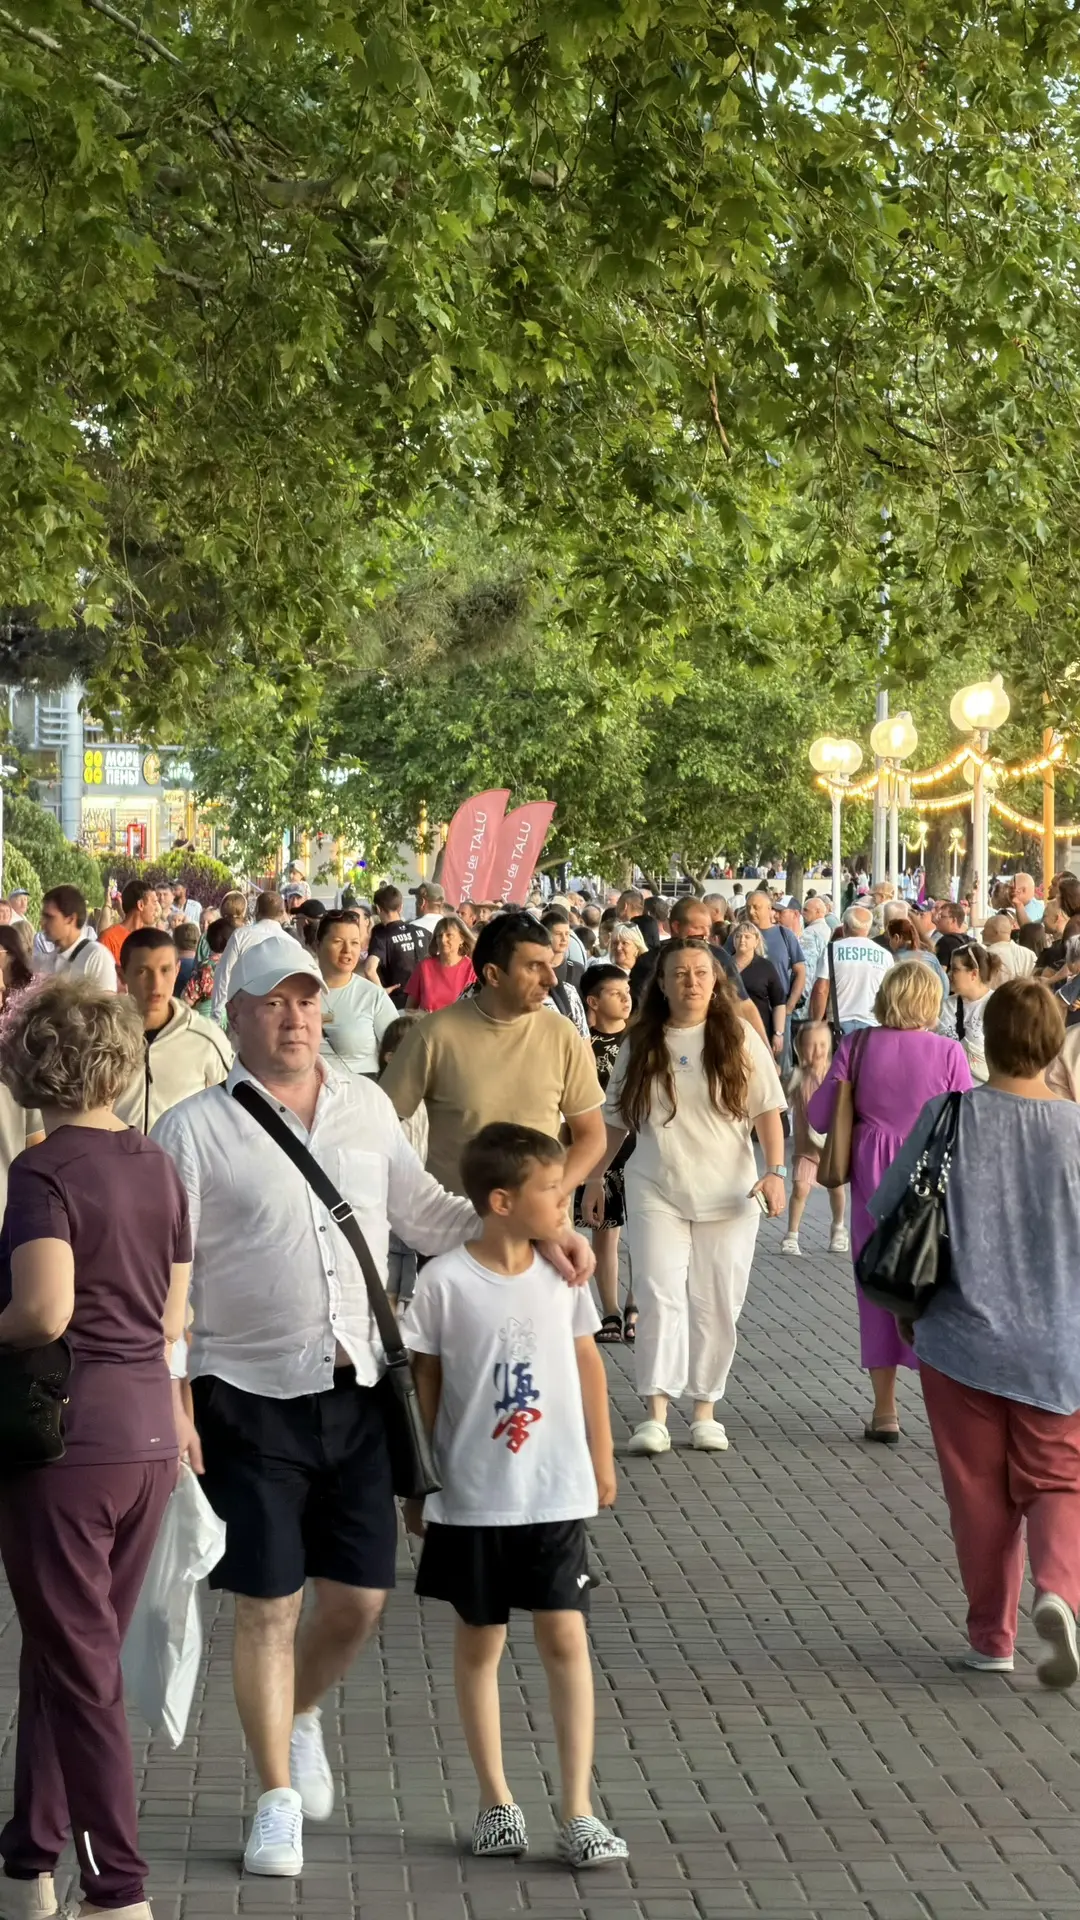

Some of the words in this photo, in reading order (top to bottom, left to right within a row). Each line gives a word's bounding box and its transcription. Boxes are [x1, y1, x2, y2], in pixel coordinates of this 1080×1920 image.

[105, 768, 139, 785] ПЕНЫ
[470, 812, 487, 852] TALU
[511, 821, 531, 859] TALU
[467, 856, 479, 870] de
[507, 864, 519, 879] de
[838, 947, 884, 965] RESPECT
